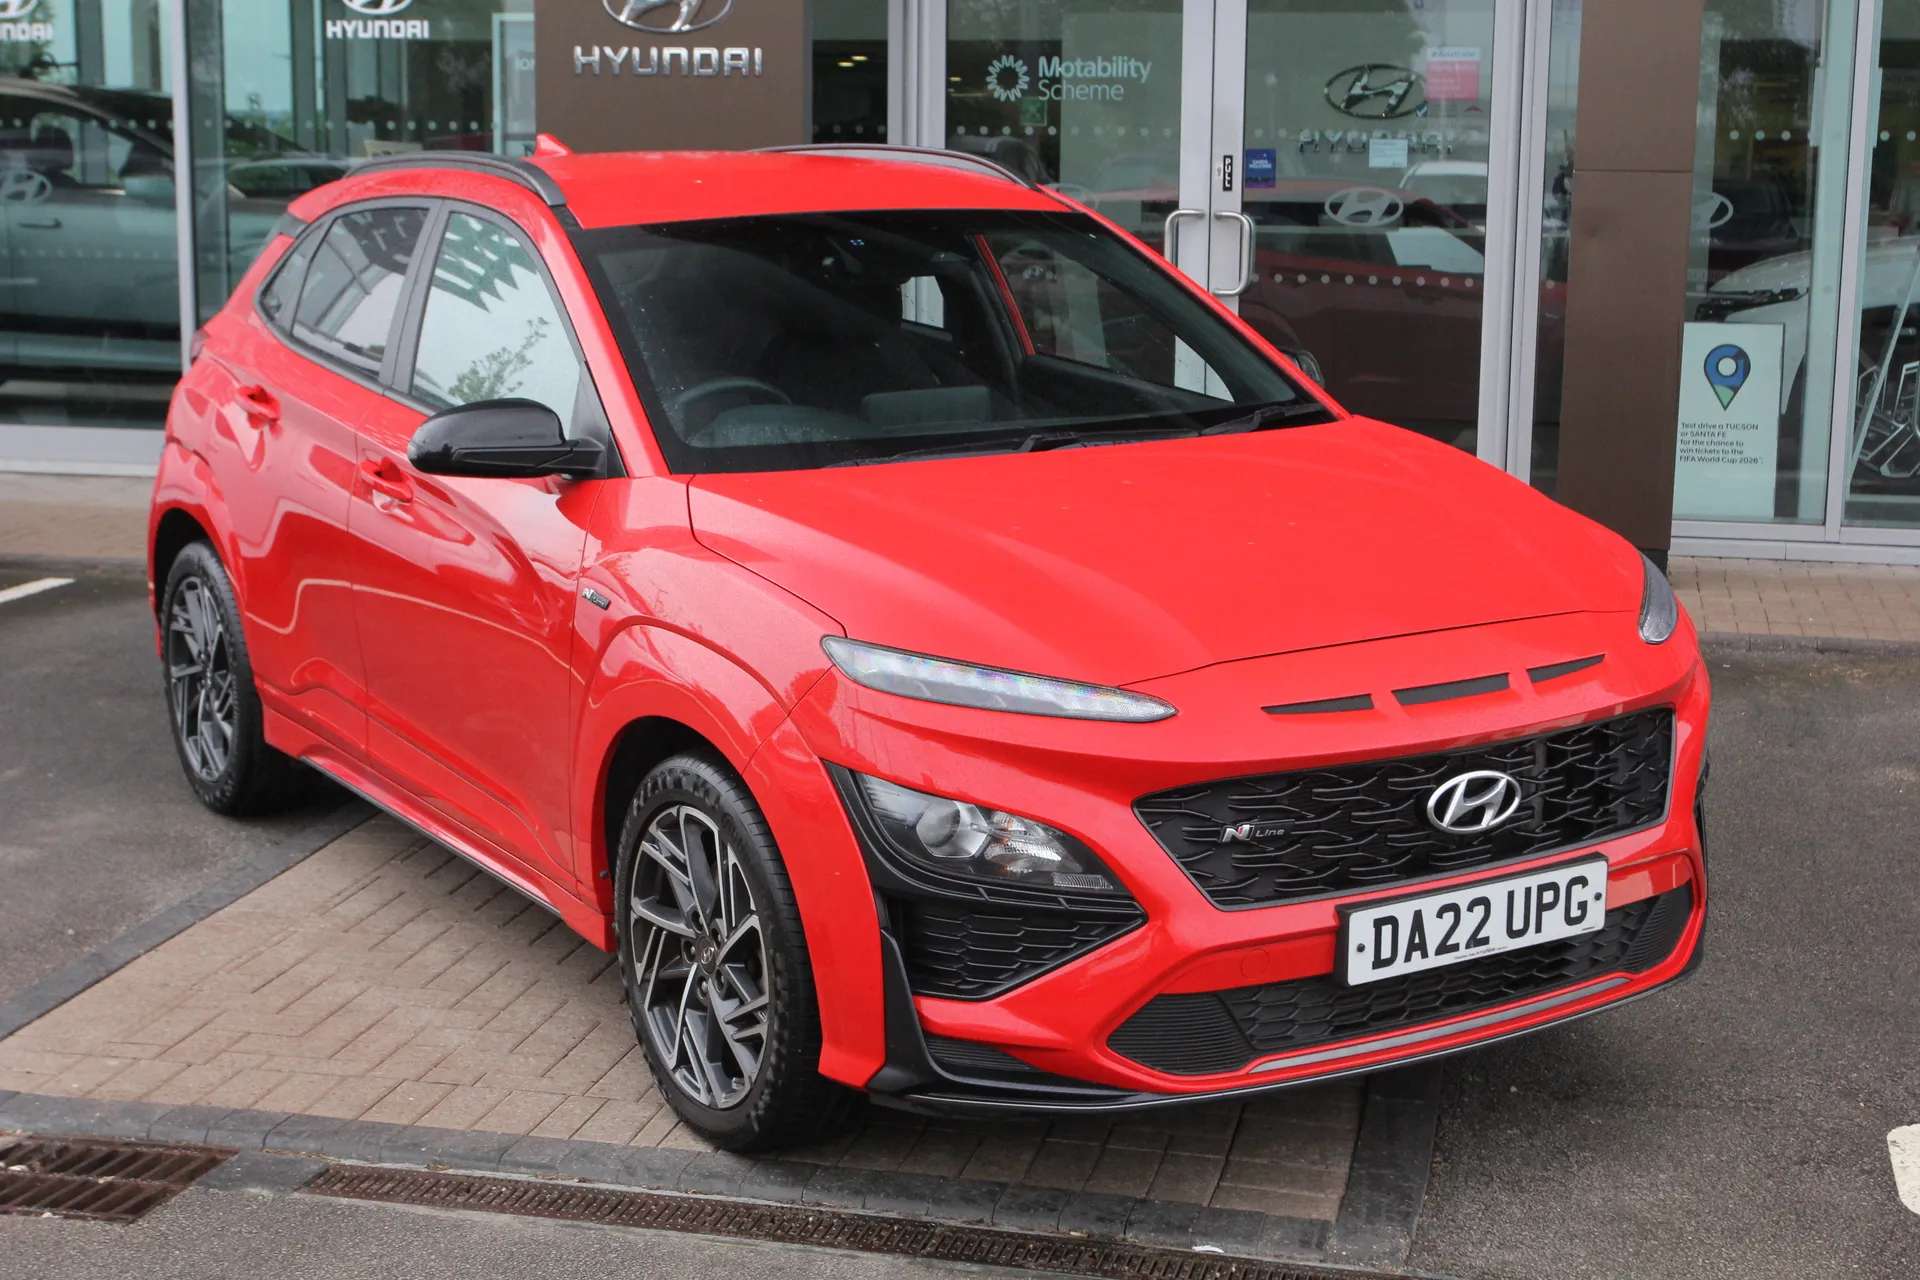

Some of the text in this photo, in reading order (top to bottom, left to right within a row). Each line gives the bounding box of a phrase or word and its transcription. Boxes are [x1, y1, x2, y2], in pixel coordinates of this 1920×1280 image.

[326, 20, 430, 39] HYUNDAI
[573, 45, 763, 77] HYUNDAI
[1038, 55, 1152, 83] Motability
[1038, 79, 1125, 101] Scheme
[1224, 157, 1232, 188] PULL
[1681, 422, 1696, 430] Test
[1698, 422, 1717, 431] drive
[1726, 423, 1759, 431] TUCSON
[1222, 824, 1285, 842] N Line
[1371, 875, 1589, 970] DA22 UPG
